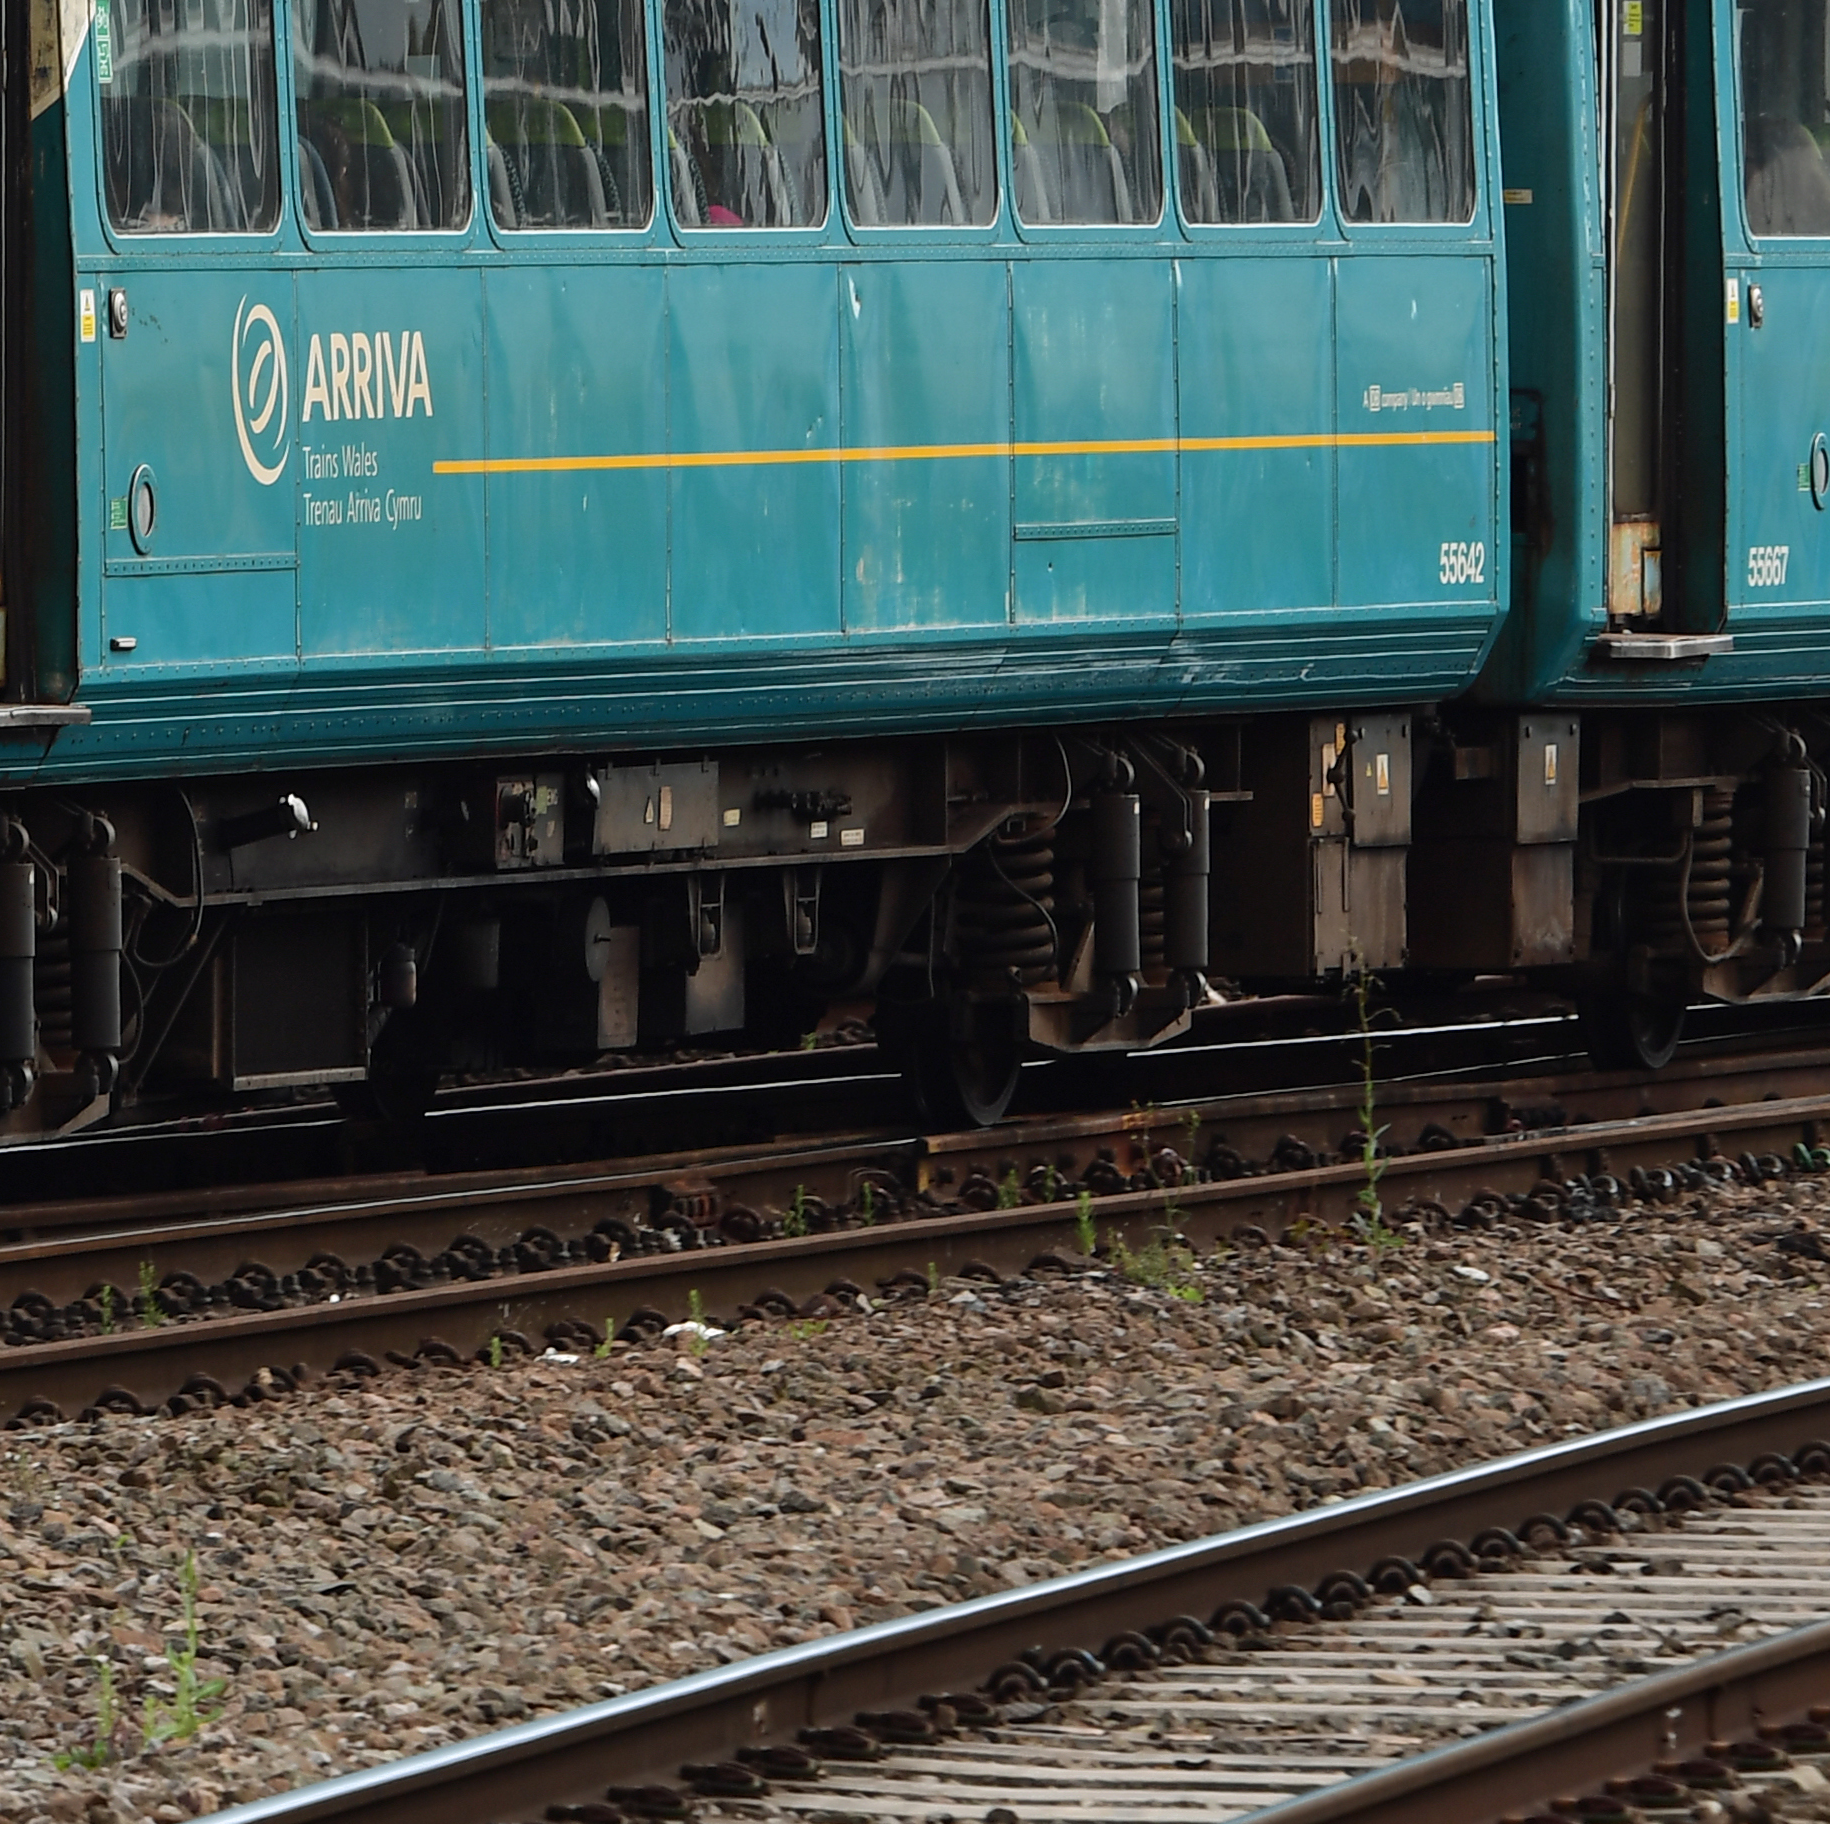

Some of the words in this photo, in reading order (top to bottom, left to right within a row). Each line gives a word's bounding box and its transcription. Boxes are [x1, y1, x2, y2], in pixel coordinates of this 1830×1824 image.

[302, 331, 434, 423] ARRIVA
[302, 444, 339, 480] Trains
[342, 441, 379, 478] Wales
[303, 492, 343, 526] Trenau
[346, 488, 381, 524] Arriva
[385, 488, 422, 531] Cymru
[1439, 541, 1485, 585] 55642
[1748, 545, 1790, 587] 55667
